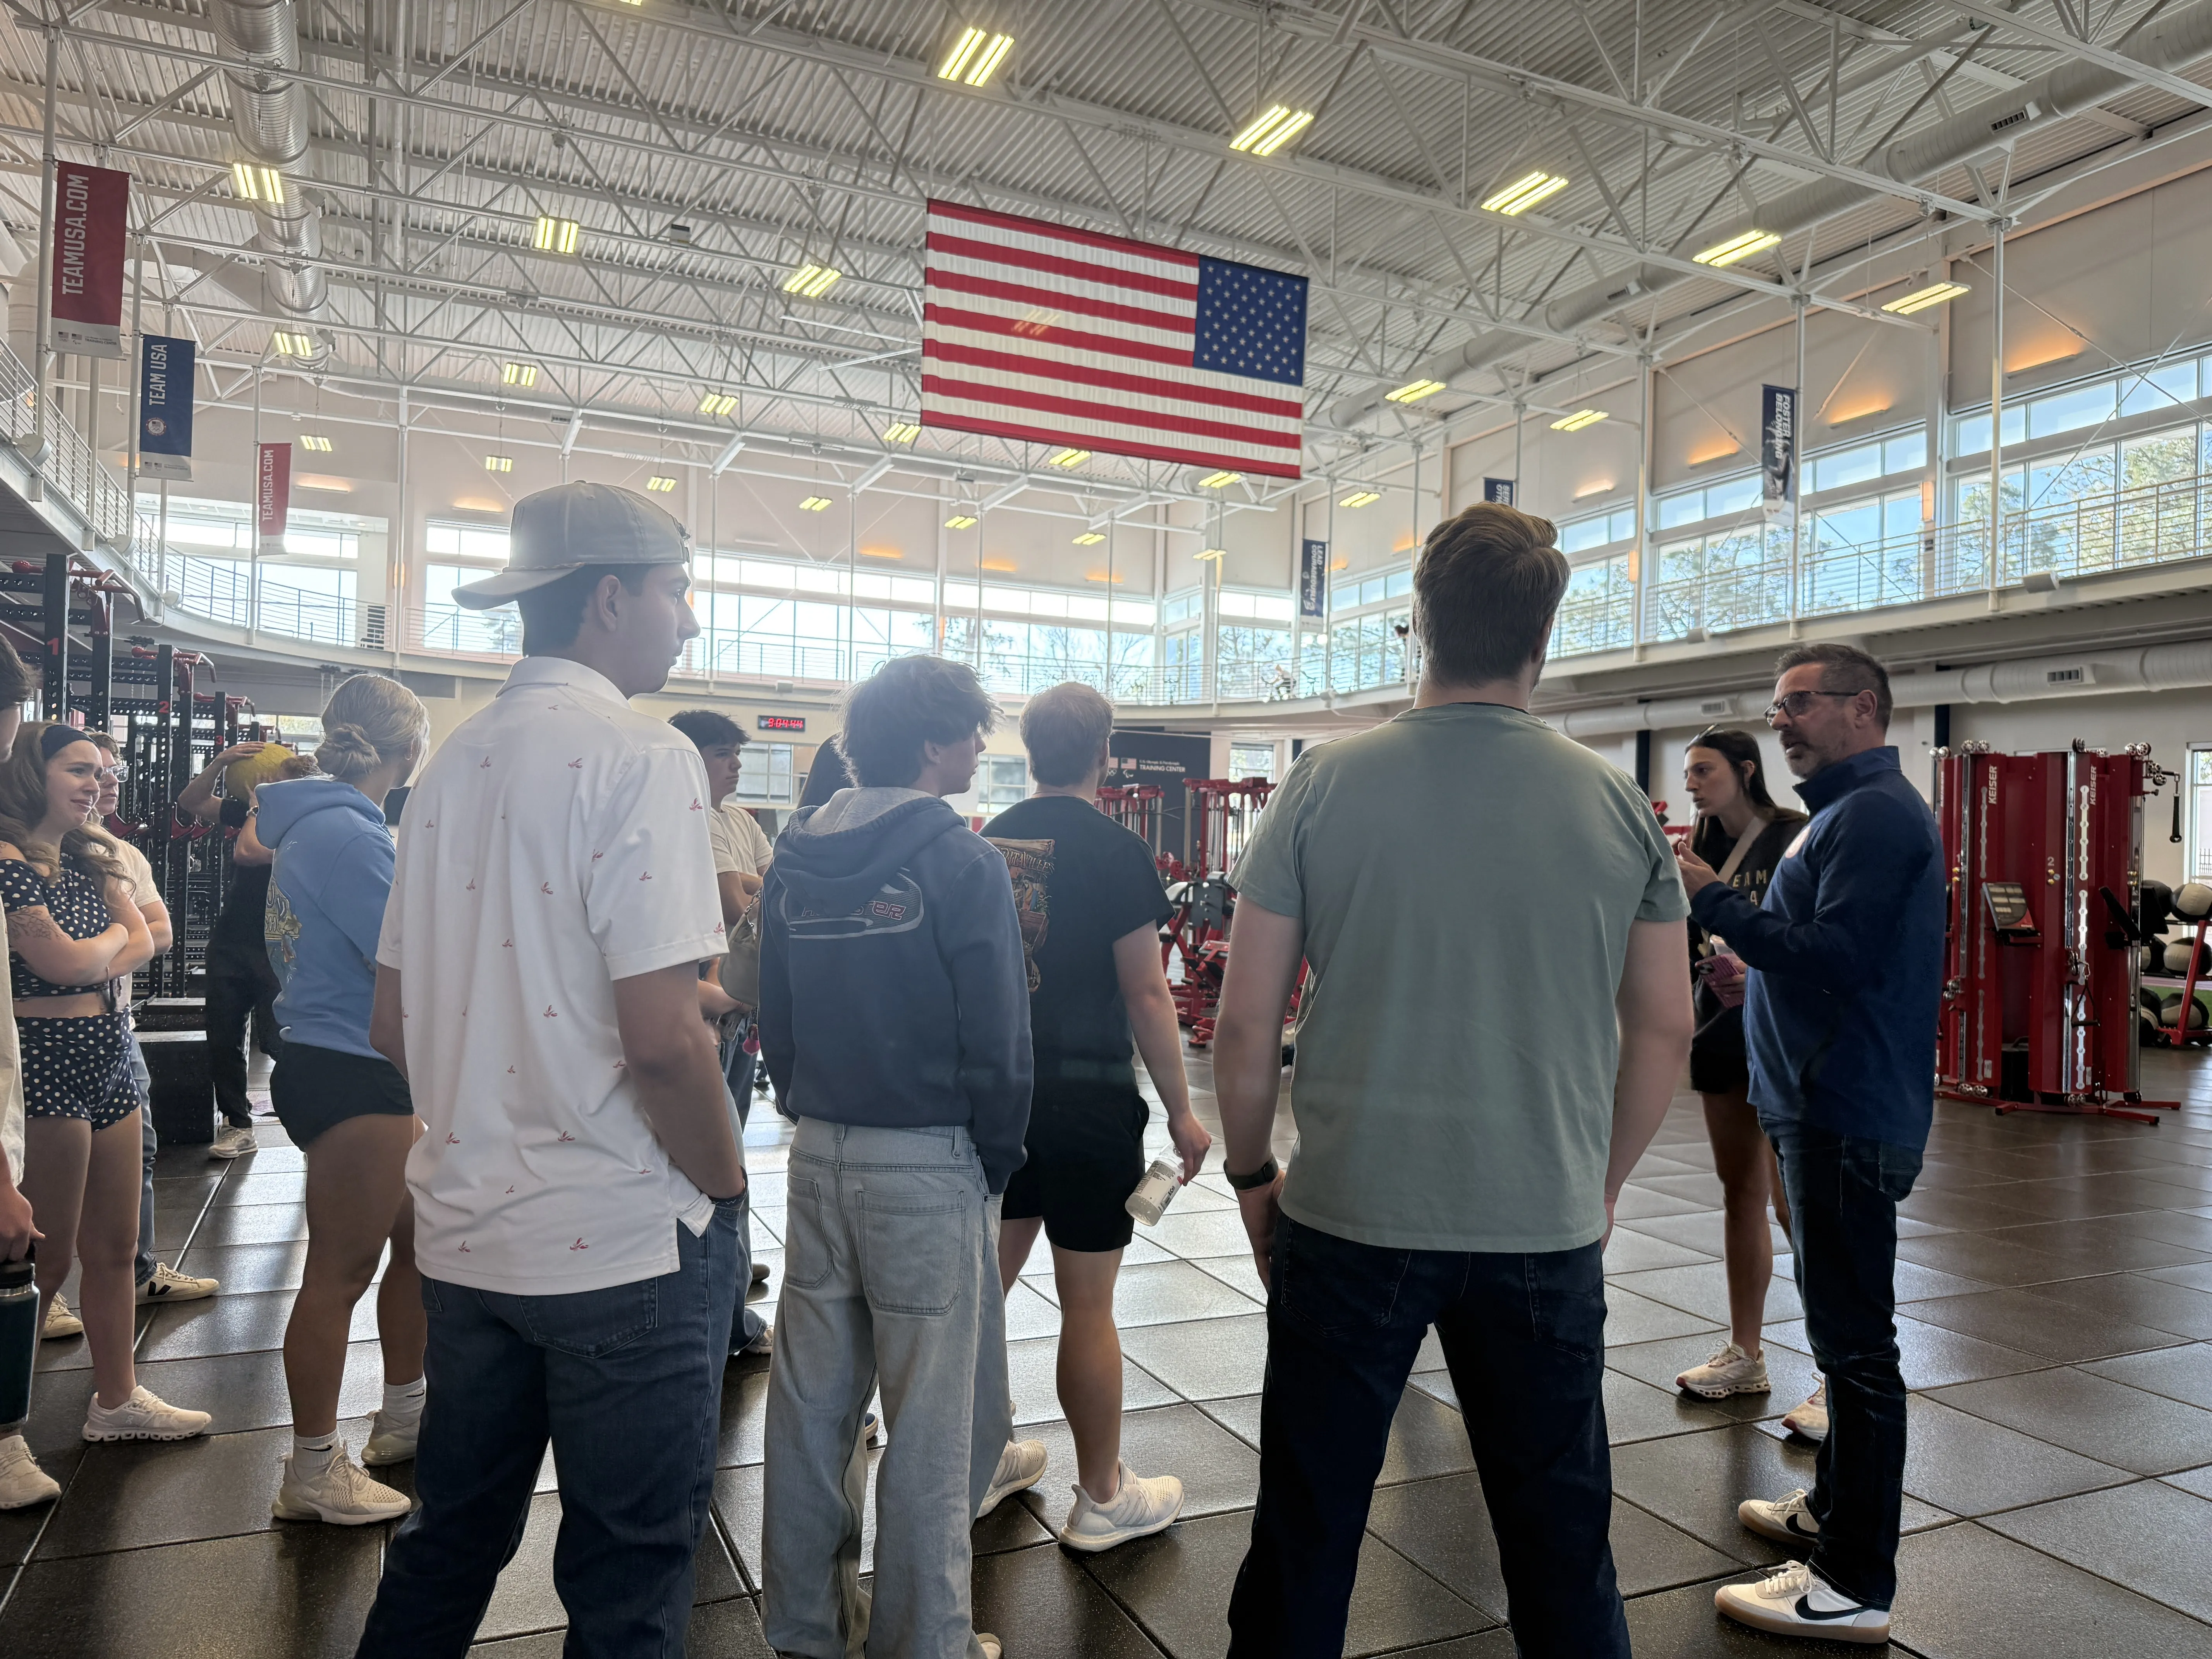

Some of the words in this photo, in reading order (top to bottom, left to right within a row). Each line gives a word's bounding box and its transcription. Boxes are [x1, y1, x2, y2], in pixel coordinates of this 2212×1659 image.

[62, 173, 89, 294] TEAMUSA.COM
[150, 345, 167, 370] USA
[149, 373, 166, 405] TEAM
[1782, 393, 1791, 438] FOSTER
[263, 450, 274, 521] TEAMUSA.COM
[47, 638, 59, 655] 1
[159, 701, 169, 713] 2
[216, 735, 223, 745] 3
[1989, 765, 1997, 805] KEISER
[2047, 857, 2054, 866] 2
